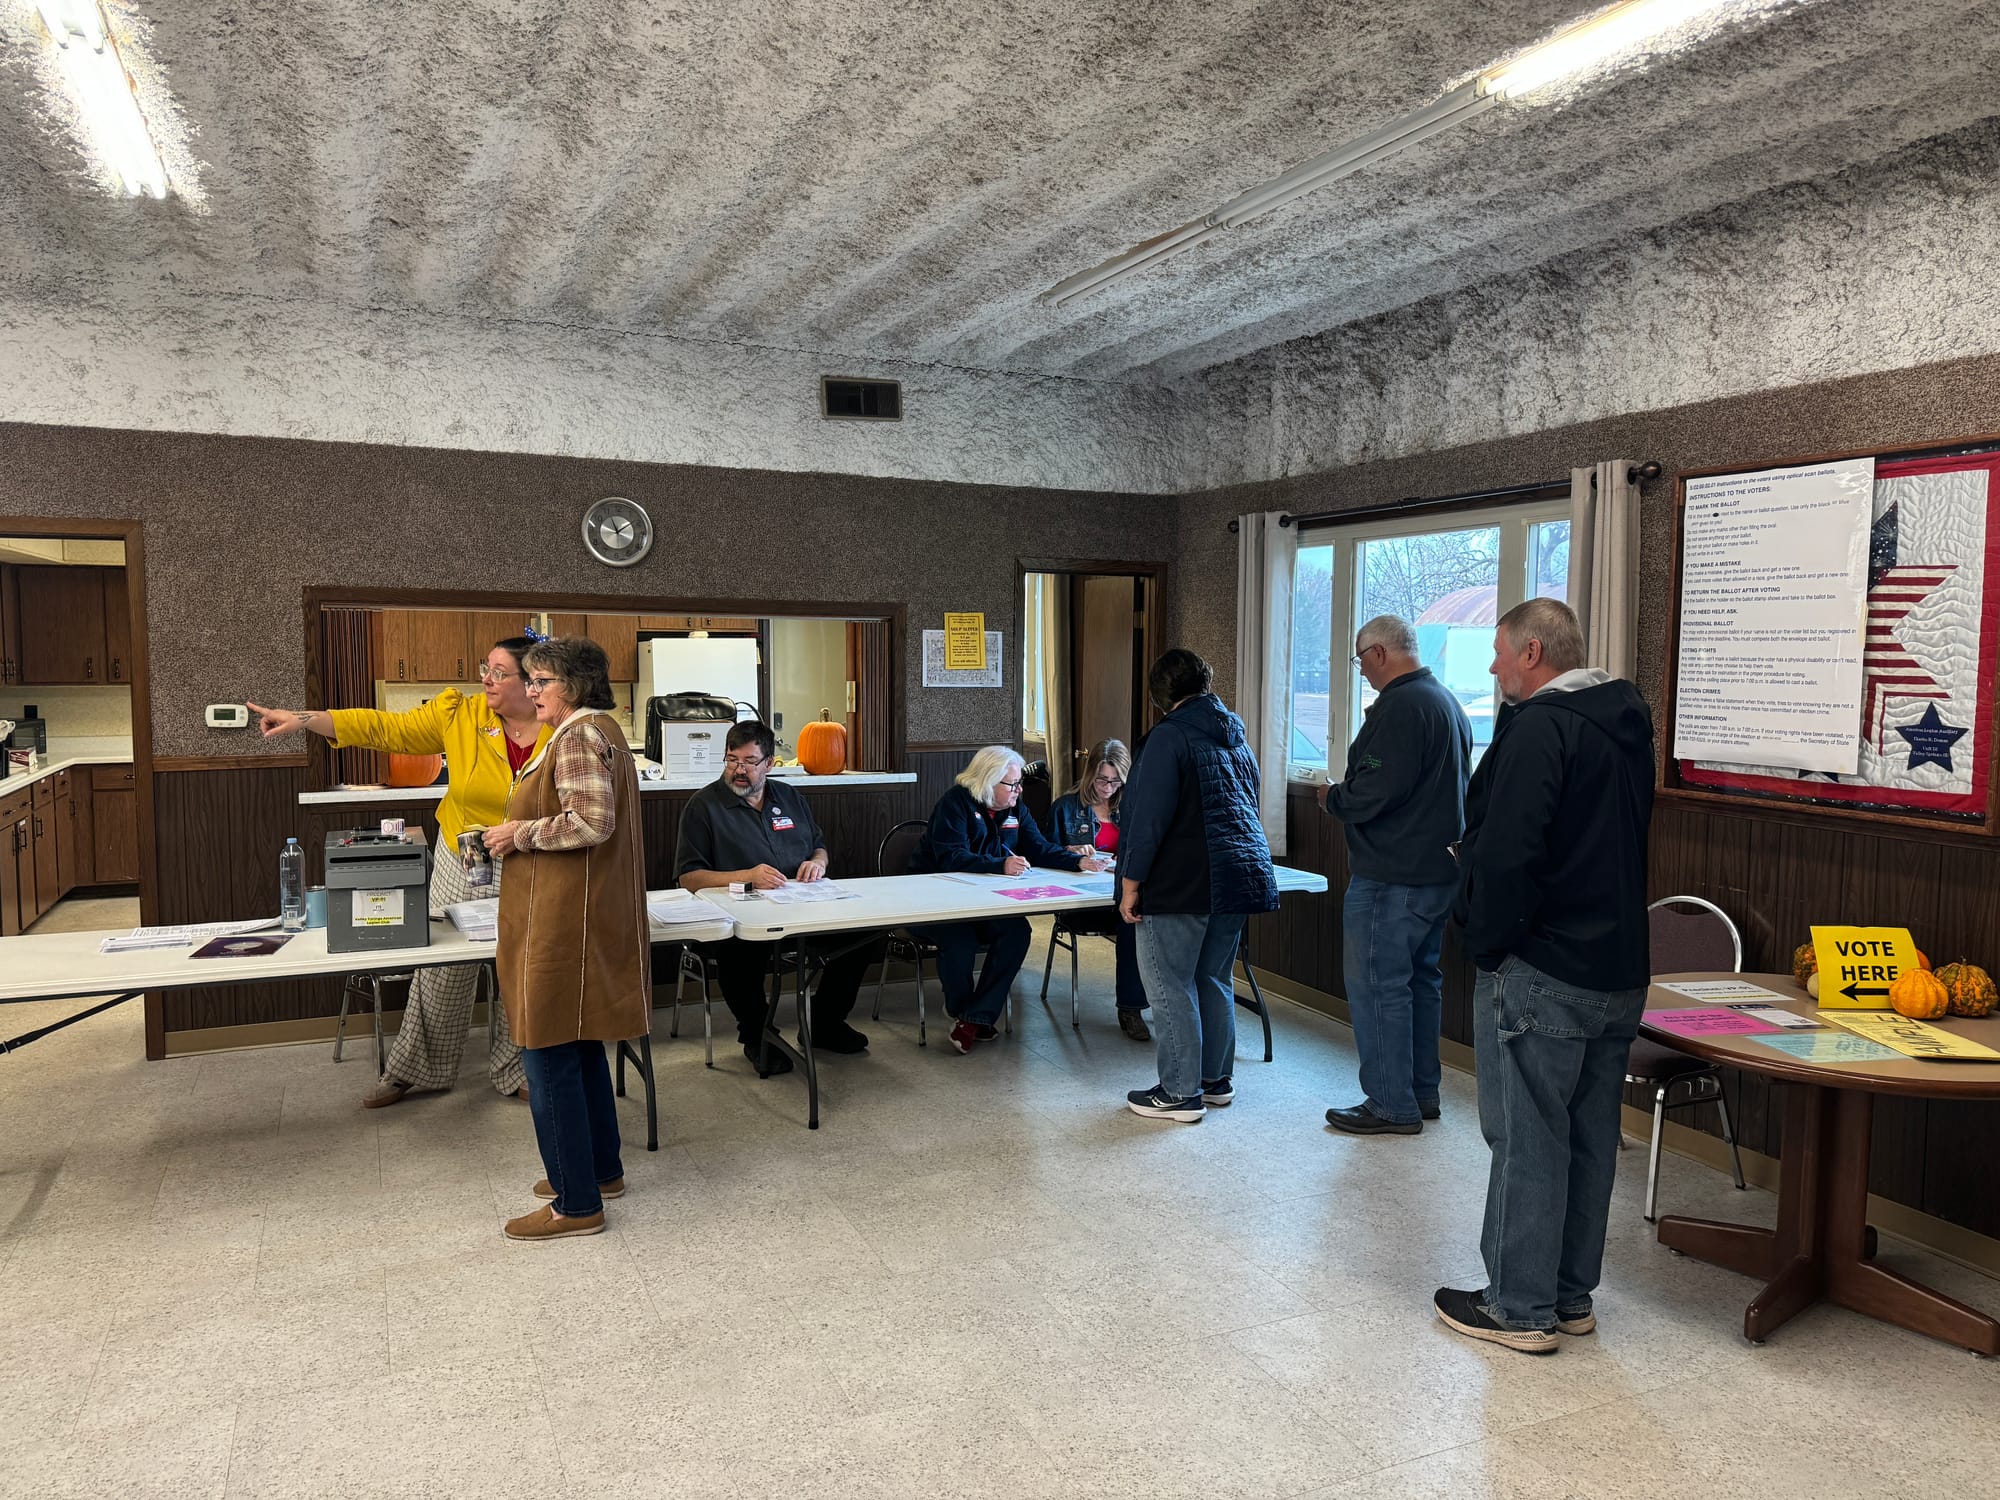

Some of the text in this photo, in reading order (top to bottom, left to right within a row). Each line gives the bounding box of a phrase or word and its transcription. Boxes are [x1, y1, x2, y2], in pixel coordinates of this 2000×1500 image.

[1689, 490, 1725, 500] INSTRUCTIONS
[1835, 941, 1895, 956] VOTE
[1841, 966, 1898, 981] HERE
